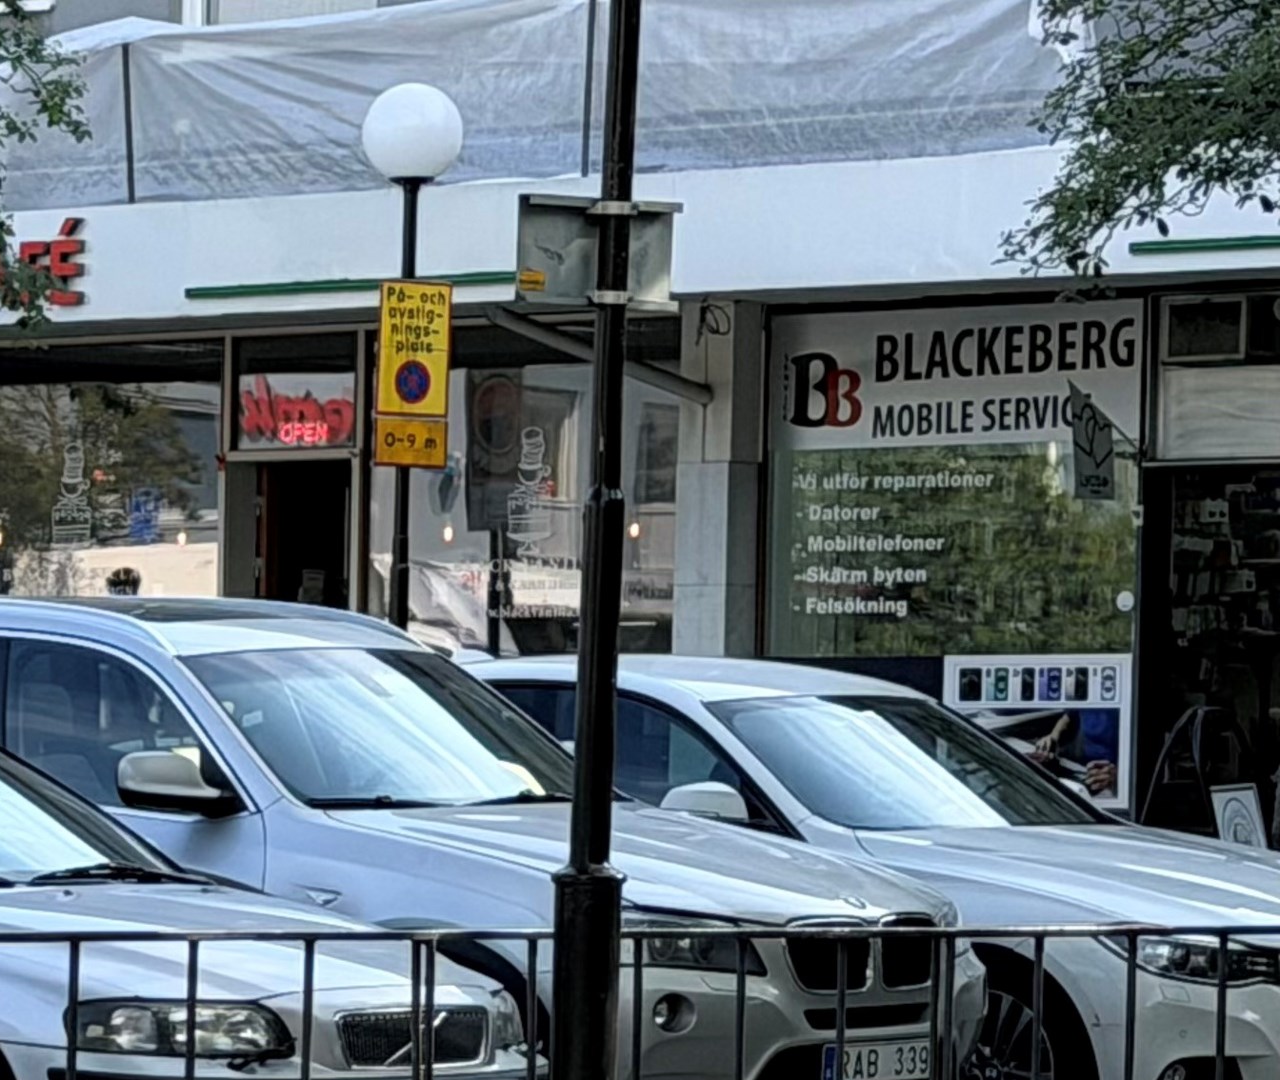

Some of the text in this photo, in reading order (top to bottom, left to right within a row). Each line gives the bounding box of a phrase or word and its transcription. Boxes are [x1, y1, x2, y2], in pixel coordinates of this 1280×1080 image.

[420, 291, 446, 306] och
[388, 304, 444, 324] avstig-
[391, 322, 440, 340] nings-
[875, 317, 1135, 383] BLACKEBERG
[872, 394, 1091, 439] MOBILE SERVIC
[278, 421, 329, 445] OPEN
[384, 431, 437, 450] 0-9 m
[822, 472, 868, 490] utför
[873, 471, 994, 492] reparationer
[809, 504, 880, 521] Datorer
[807, 534, 945, 552] Mobiltelefoner
[806, 566, 927, 589] Skärm byten
[806, 597, 908, 618] Felsökning
[842, 1046, 929, 1079] RAB 339
